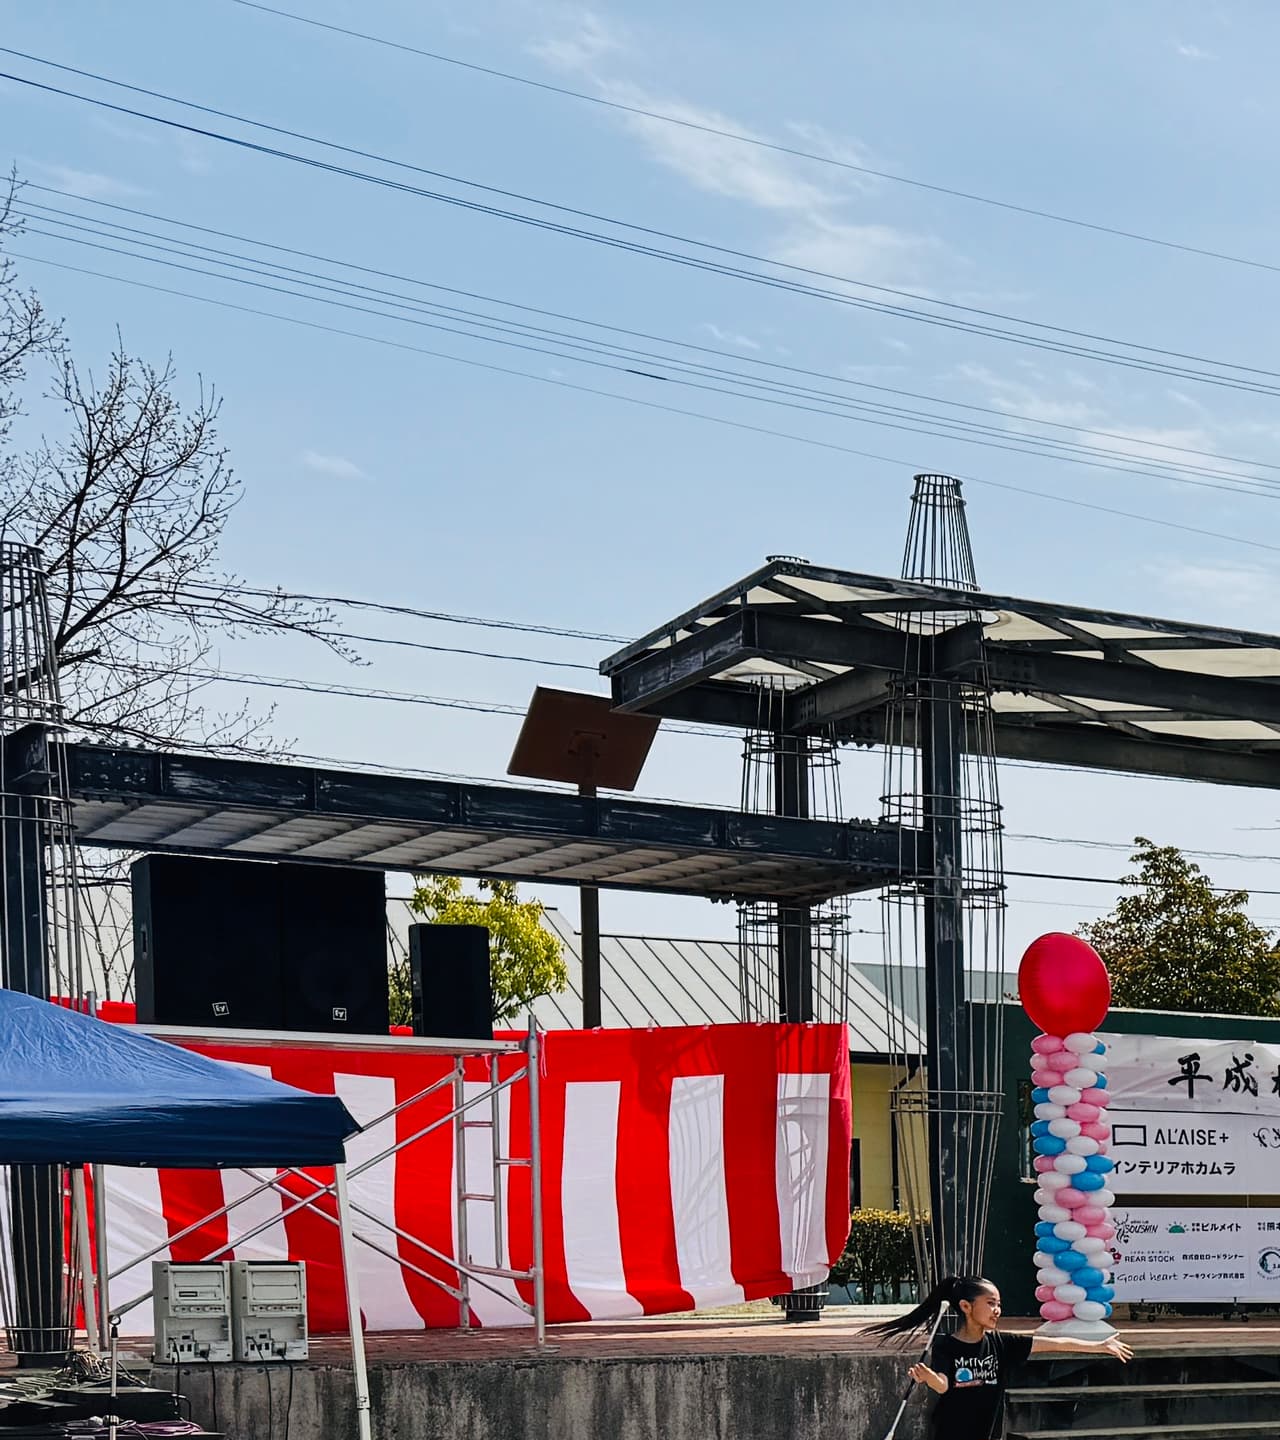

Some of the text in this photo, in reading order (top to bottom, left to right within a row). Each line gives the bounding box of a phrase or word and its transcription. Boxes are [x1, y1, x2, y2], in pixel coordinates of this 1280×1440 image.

[1201, 1222, 1242, 1232] ビルメイト
[1148, 1255, 1175, 1263] STOCK
[1117, 1271, 1179, 1284] Good heart
